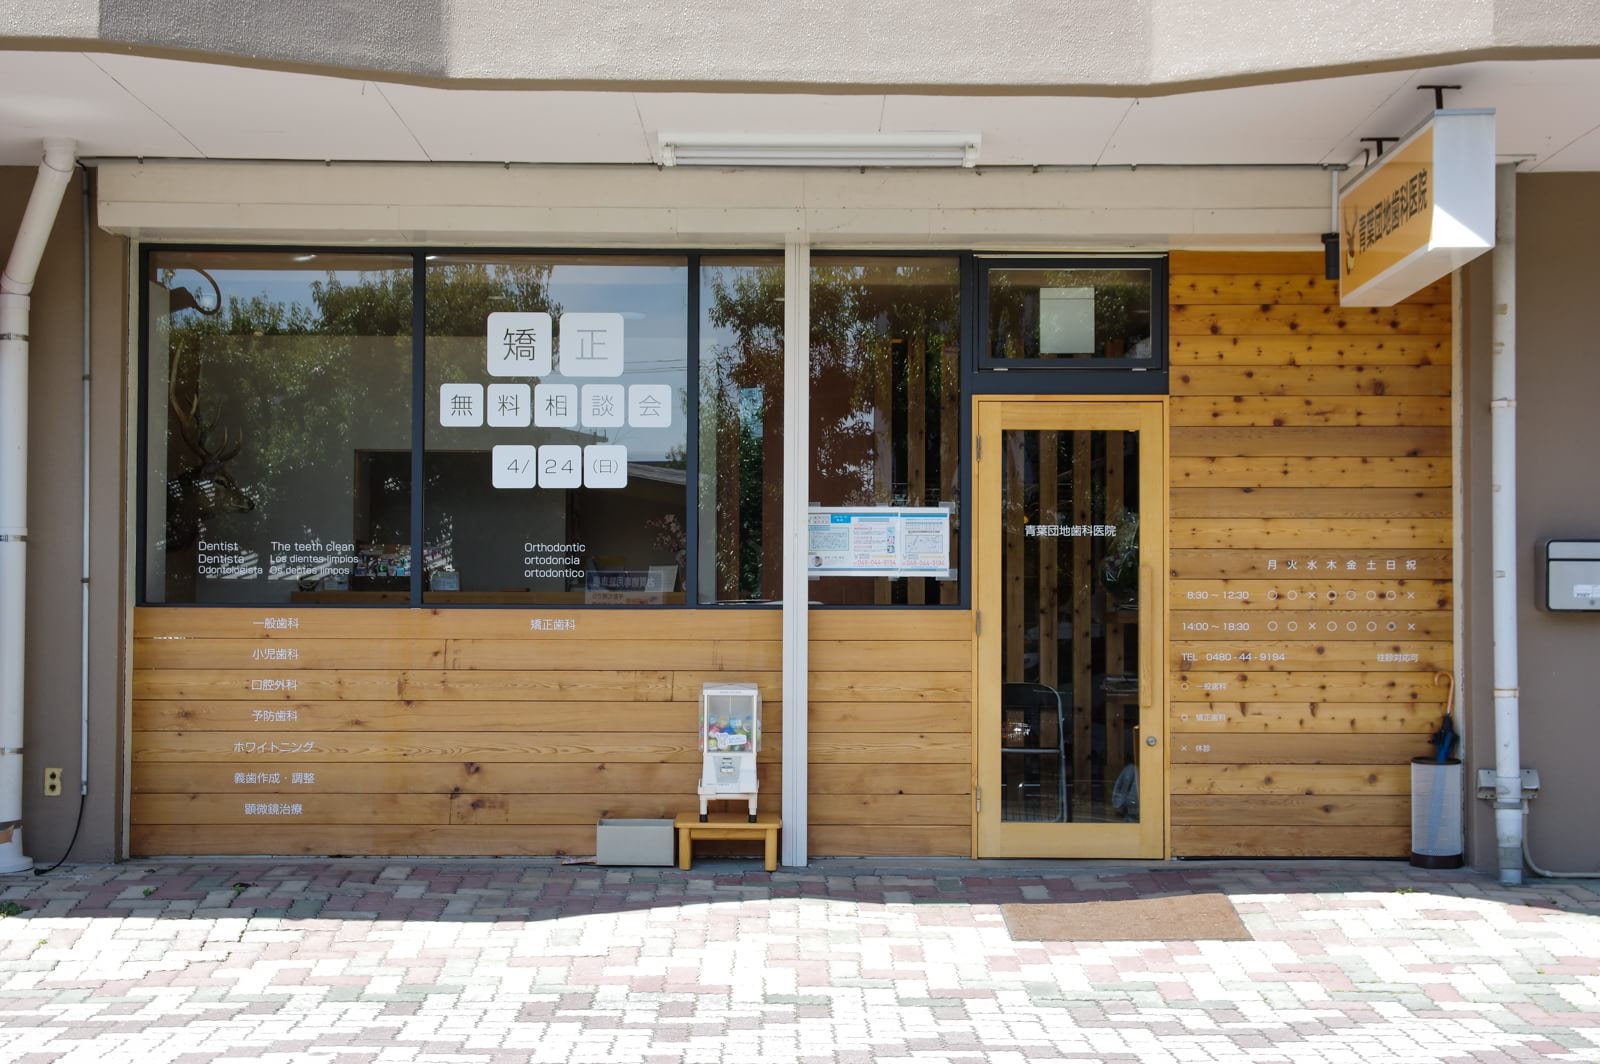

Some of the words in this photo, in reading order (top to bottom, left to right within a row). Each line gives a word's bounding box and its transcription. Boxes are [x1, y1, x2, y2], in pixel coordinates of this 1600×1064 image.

[1359, 168, 1427, 254] 青葉団地歯科医院
[503, 327, 608, 361] 矯正
[450, 393, 662, 418] 無料相談会
[1024, 524, 1117, 537] 青葉団地歯科医院
[198, 541, 239, 551] Dentist
[271, 541, 291, 551] The
[295, 541, 323, 551] teeth
[326, 541, 355, 551] clean
[524, 542, 586, 552] Orthodontic
[198, 554, 245, 564] Dentista
[270, 554, 288, 563] Los
[291, 554, 324, 563] dientes
[327, 554, 359, 565] limpios
[524, 555, 580, 565] ortodoncia
[198, 565, 263, 576] Odontologista
[1267, 560, 1277, 570] 月
[1286, 560, 1297, 570] 火
[1306, 560, 1317, 570] 水
[1326, 560, 1336, 570] 木
[1346, 560, 1357, 570] 金
[1366, 560, 1376, 570] 土
[1386, 560, 1395, 570] 日
[270, 566, 283, 575] Os
[287, 566, 317, 575] dentes
[320, 566, 350, 577] limpos
[524, 567, 585, 578] ortodontico
[253, 618, 299, 629] 一般歯科
[530, 618, 576, 631] 矯正歯科
[1182, 623, 1208, 631] 14:00
[1223, 623, 1249, 631] 18:30
[252, 648, 298, 660] 小児歯科
[1182, 653, 1198, 662] TEL
[251, 679, 297, 690] 口腔外科
[252, 710, 298, 721] 予防歯科
[233, 741, 315, 753] ホワイトニング
[234, 772, 315, 784] 義歯作成・調整
[244, 803, 303, 815] 顕微鏡治療
